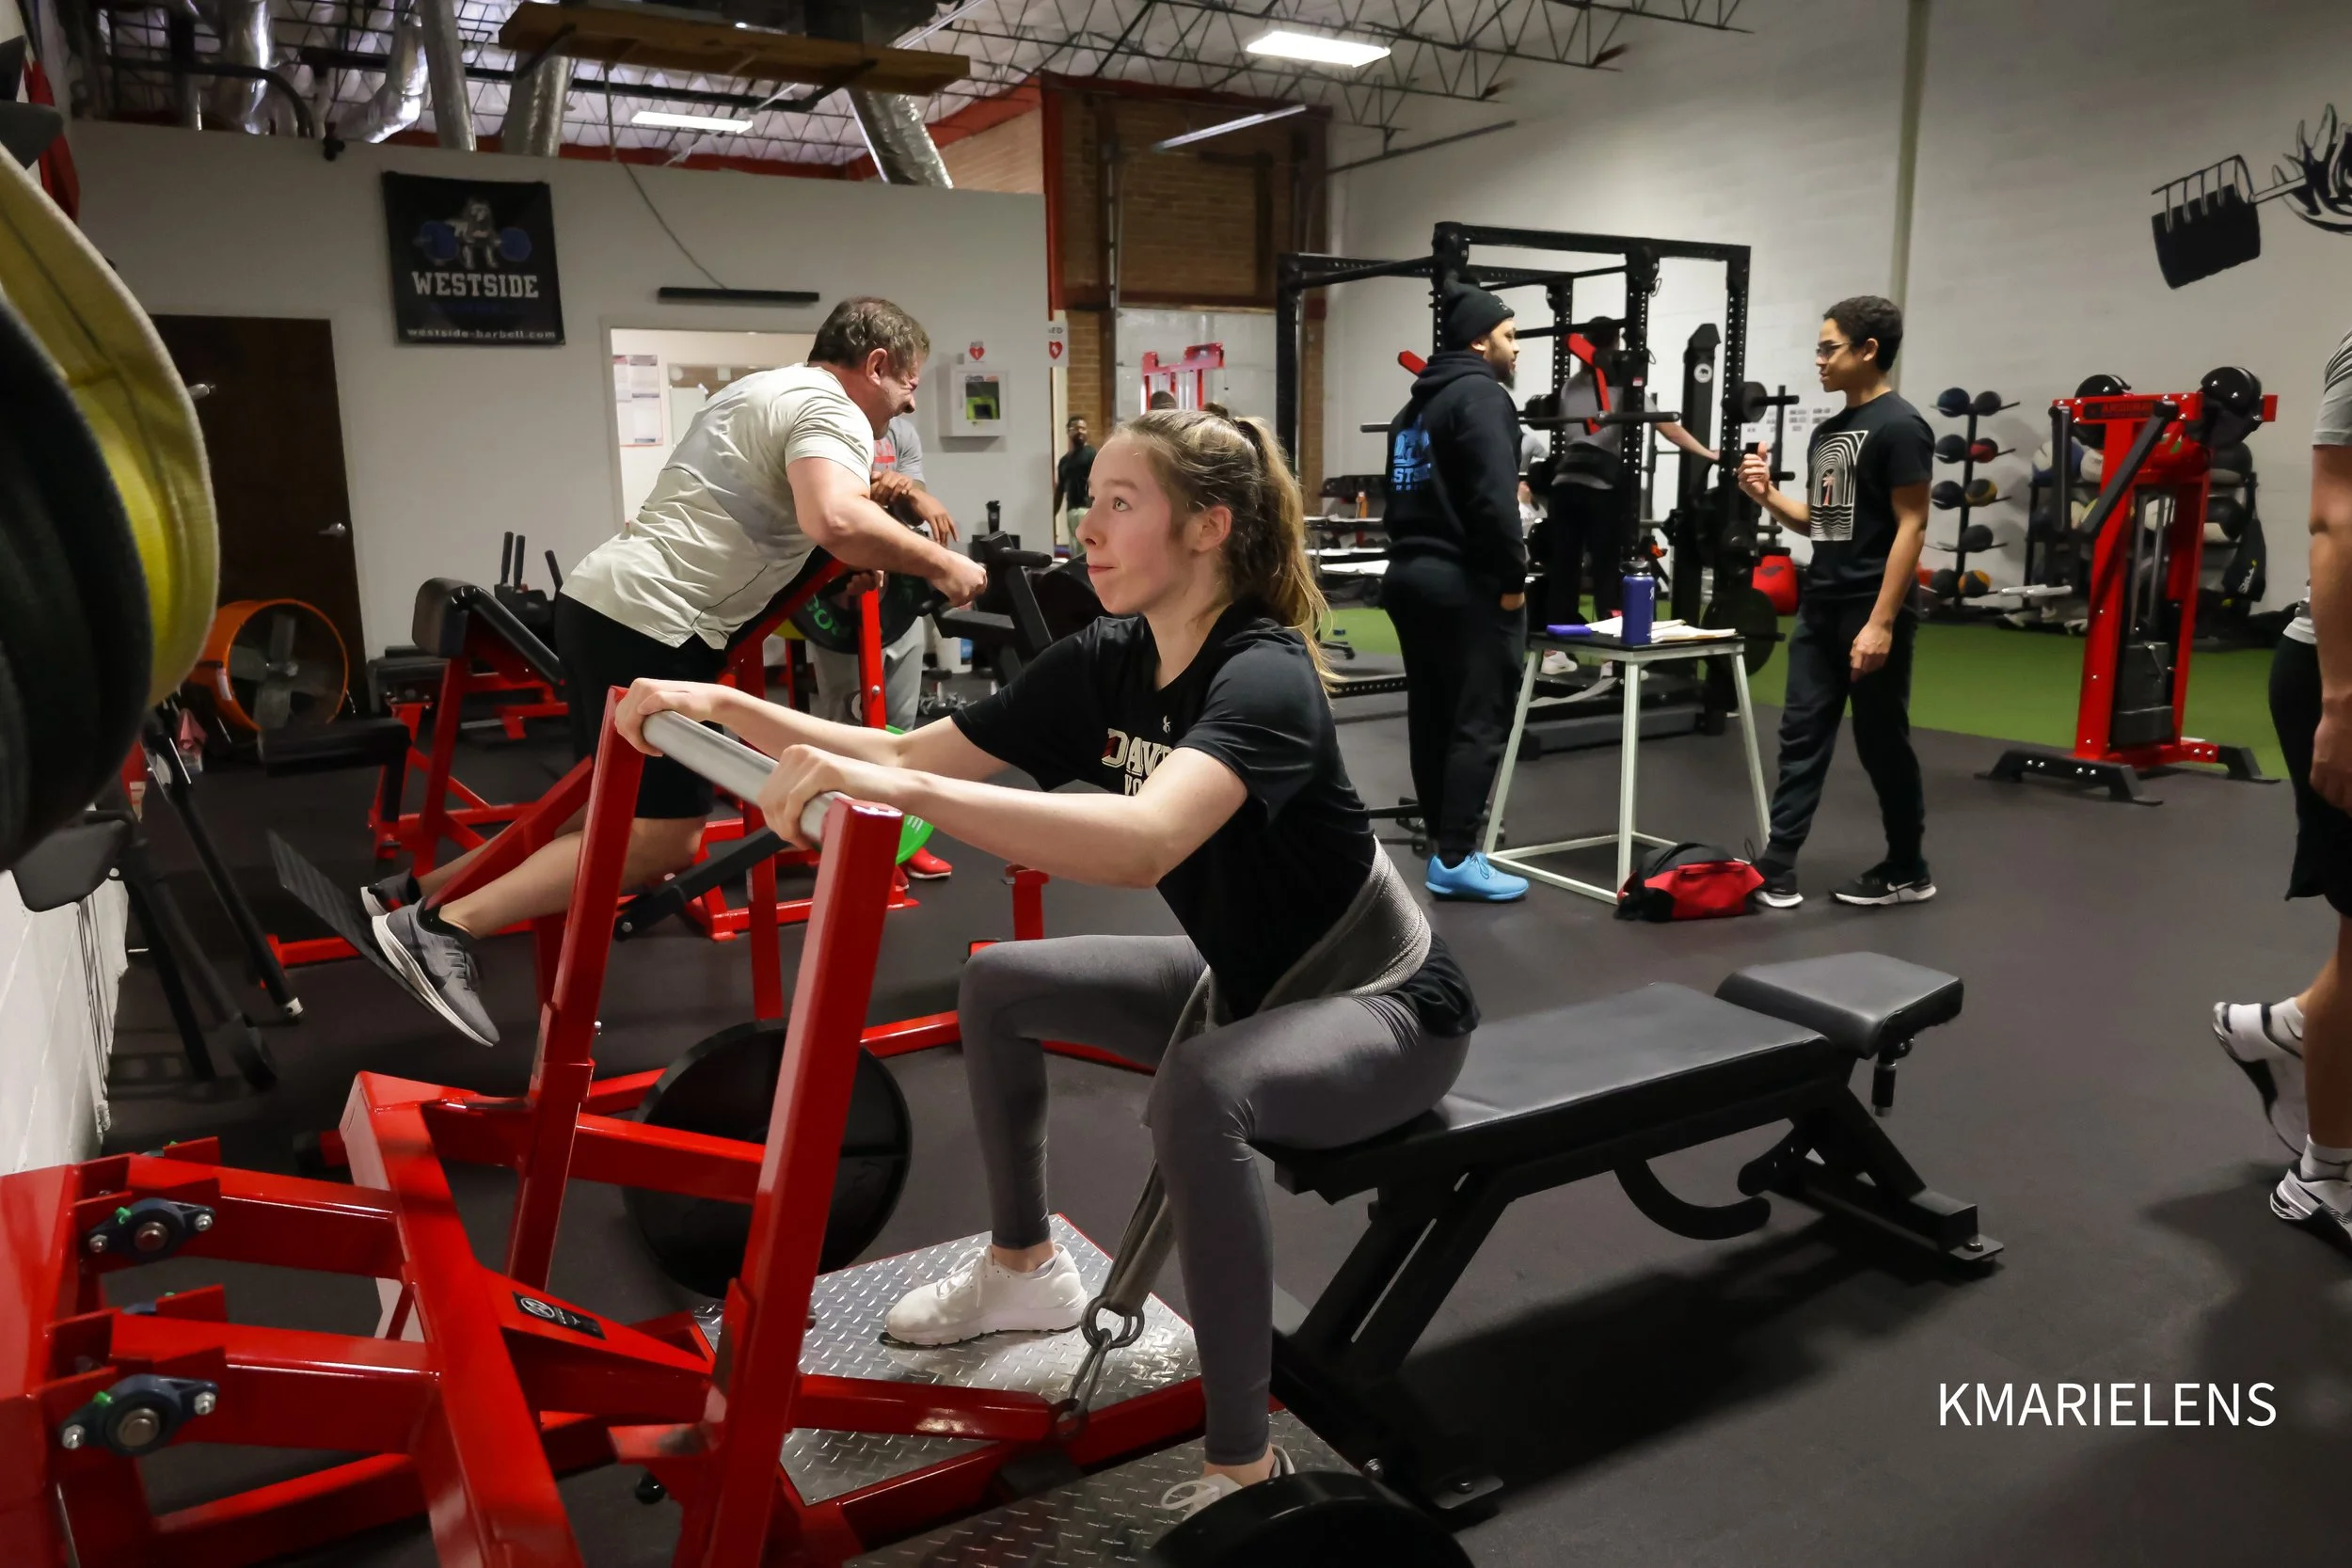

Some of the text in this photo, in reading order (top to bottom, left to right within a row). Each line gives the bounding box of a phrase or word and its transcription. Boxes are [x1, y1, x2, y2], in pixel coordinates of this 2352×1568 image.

[411, 271, 540, 298] WESTSIDE
[406, 329, 556, 340] westside-barbell.com
[1101, 727, 1173, 778] DAV
